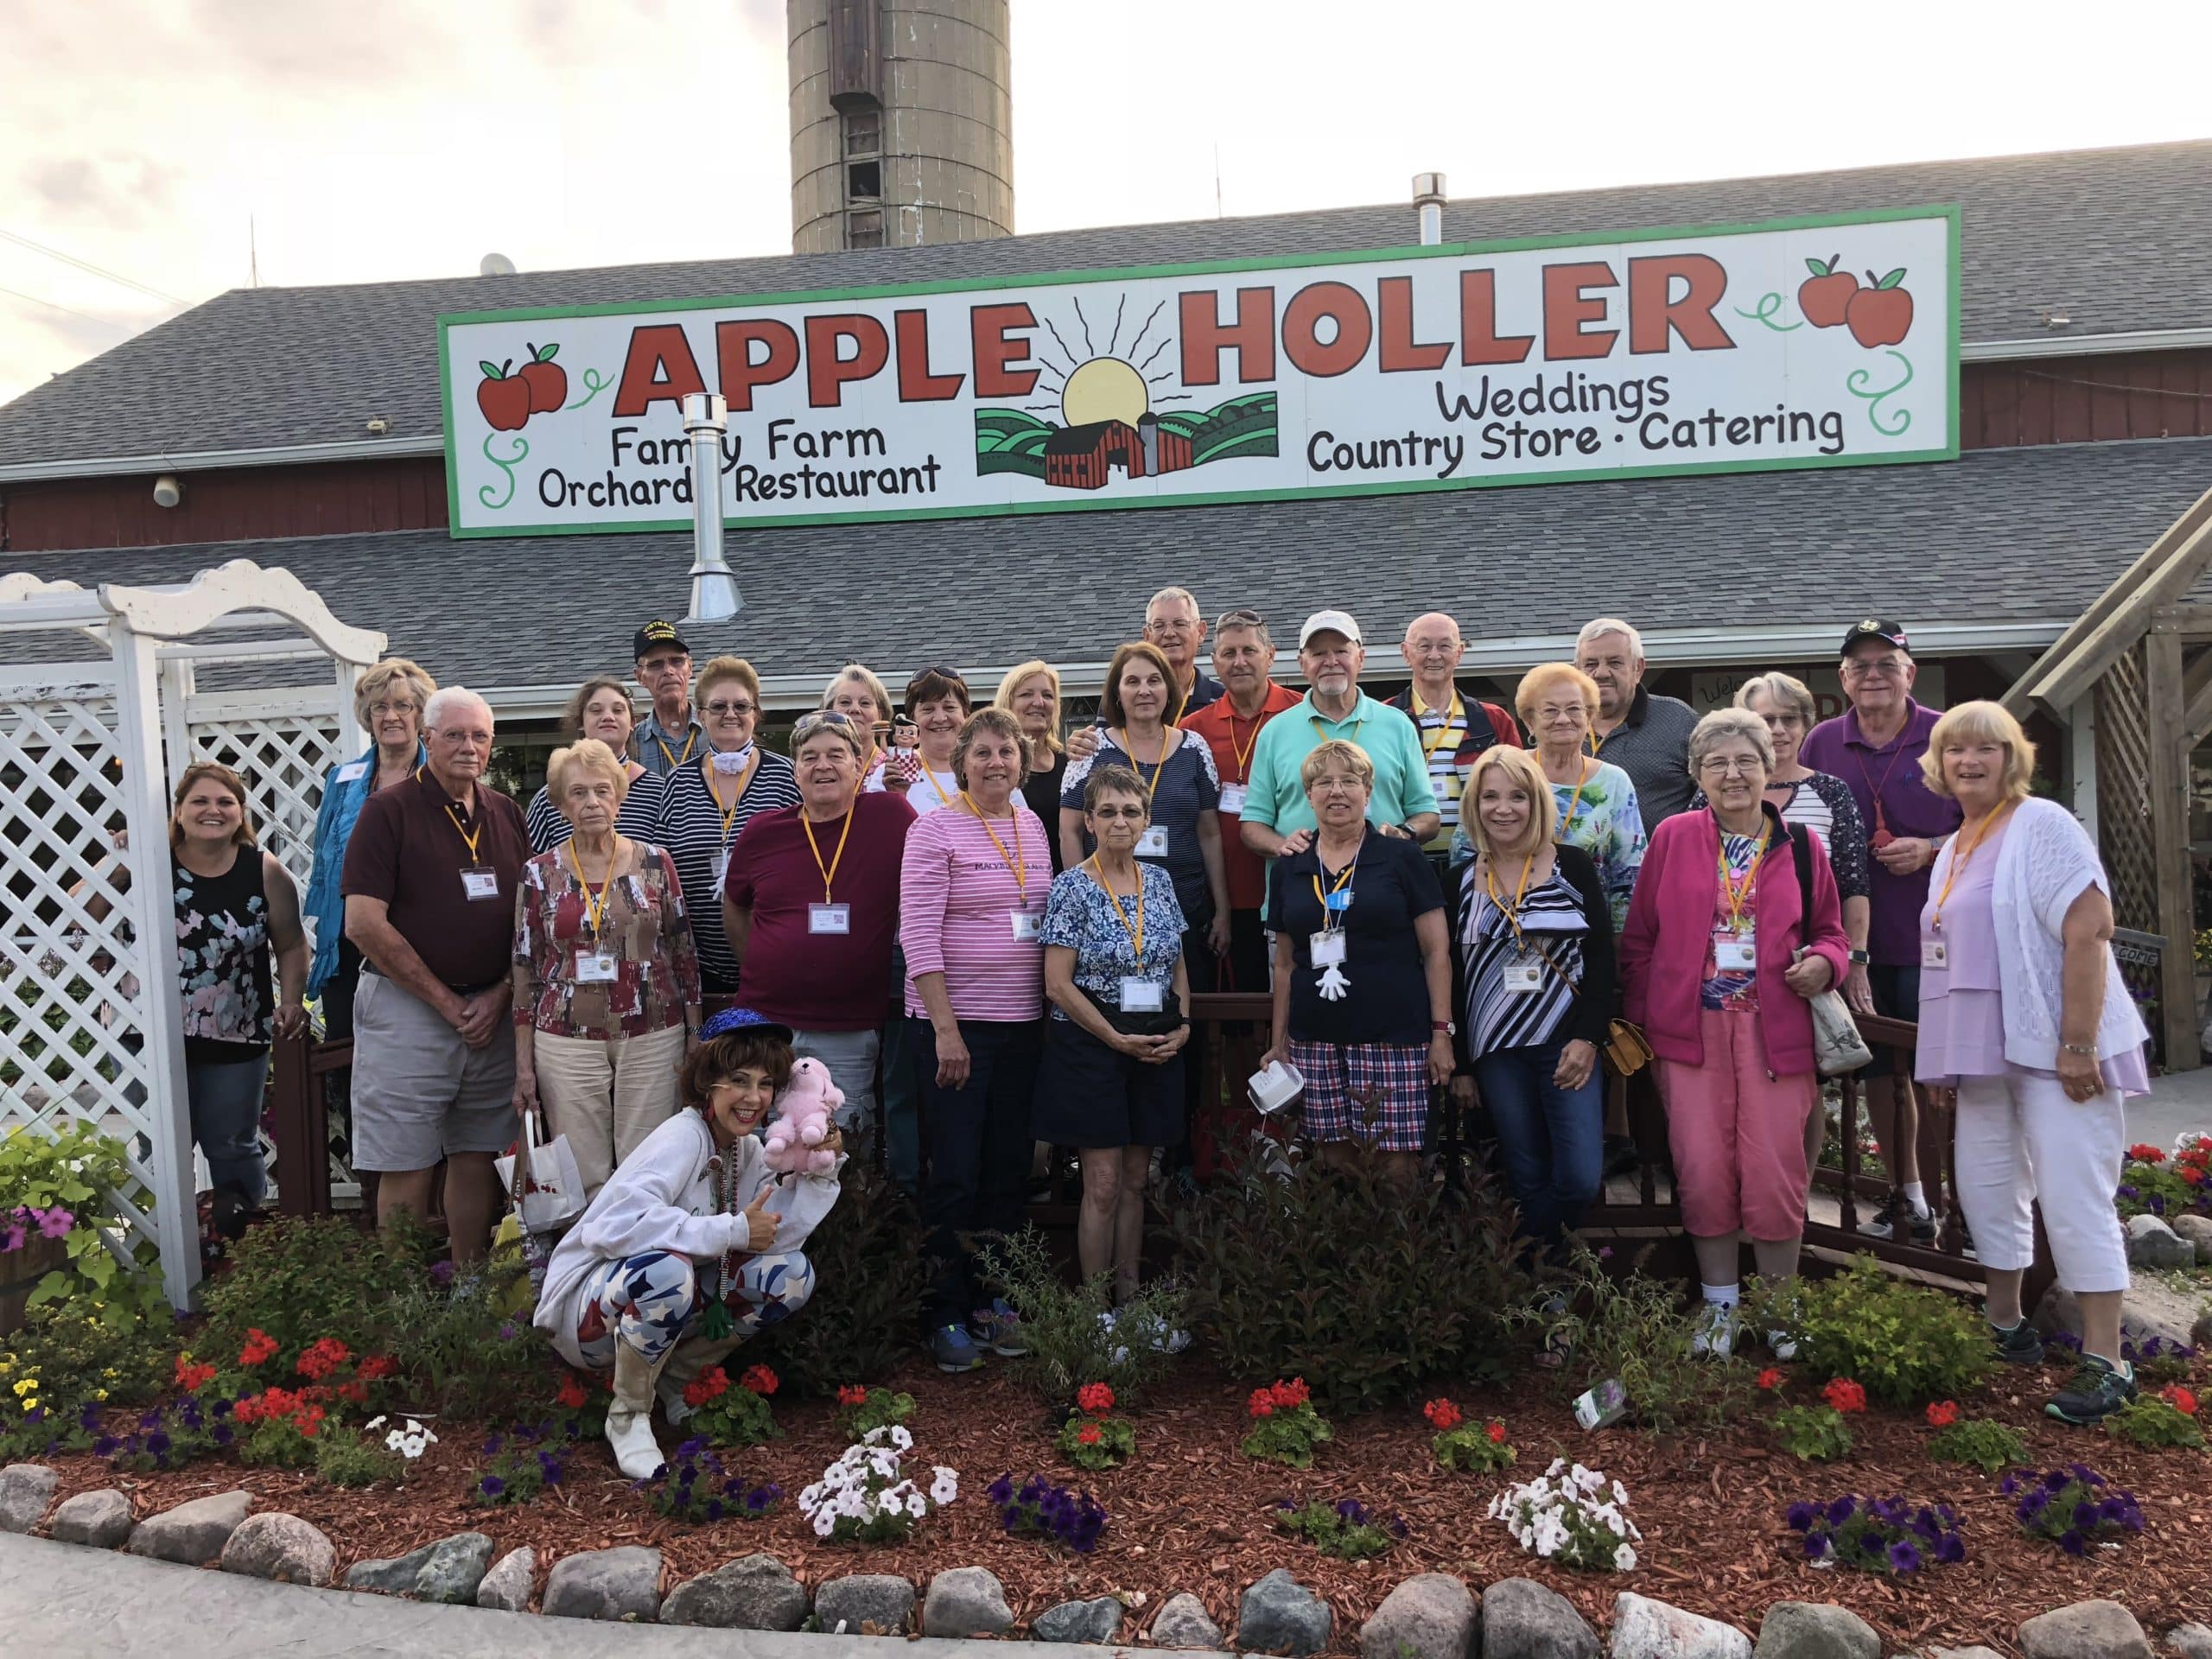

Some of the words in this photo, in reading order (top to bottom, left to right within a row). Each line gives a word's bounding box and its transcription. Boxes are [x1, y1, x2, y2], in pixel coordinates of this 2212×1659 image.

[611, 302, 1041, 417] APPLE
[1178, 252, 1738, 387] HOLLER
[1435, 371, 1670, 423] Weddings
[612, 425, 741, 474] Famy
[767, 418, 887, 460] Farm
[1307, 430, 1464, 479] Country
[1481, 420, 1601, 460] Store
[1638, 404, 1845, 454] Catering
[538, 465, 693, 508] Orchard
[735, 454, 942, 504] Restaurant
